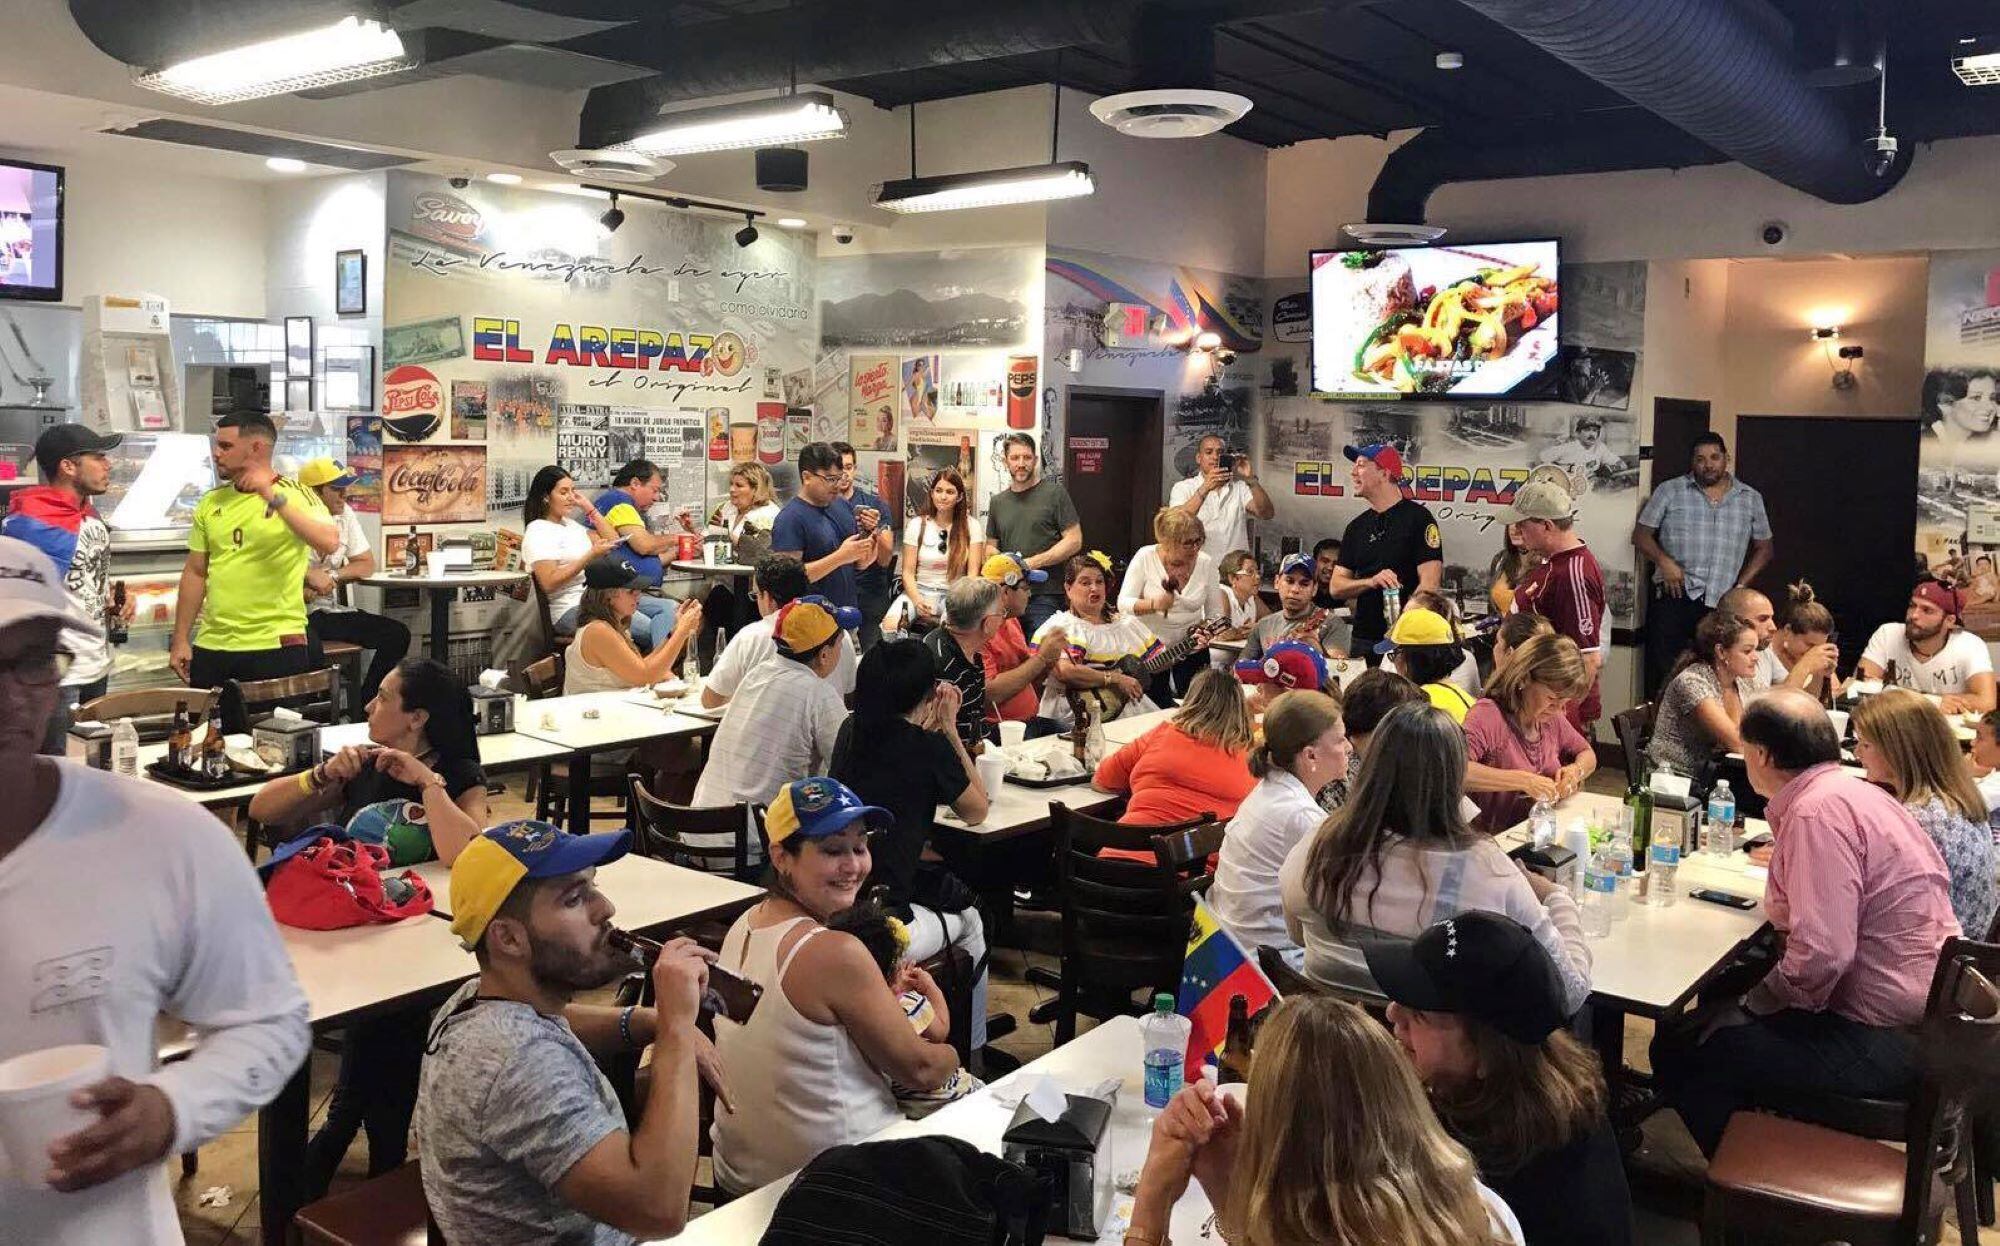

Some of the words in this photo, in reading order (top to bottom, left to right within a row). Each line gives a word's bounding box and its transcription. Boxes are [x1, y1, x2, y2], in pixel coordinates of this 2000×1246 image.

[411, 251, 463, 275] La
[480, 252, 664, 282] Venezuela
[673, 263, 712, 277] de
[721, 270, 788, 293] ayer
[720, 301, 756, 315] como
[474, 317, 534, 363] EL
[588, 371, 622, 387] el
[633, 375, 752, 402] Original
[558, 446, 607, 458] RENNY
[559, 435, 607, 446] MURIO
[1295, 462, 1344, 497] EL
[233, 527, 243, 549] 9
[68, 550, 86, 591] ECKO
